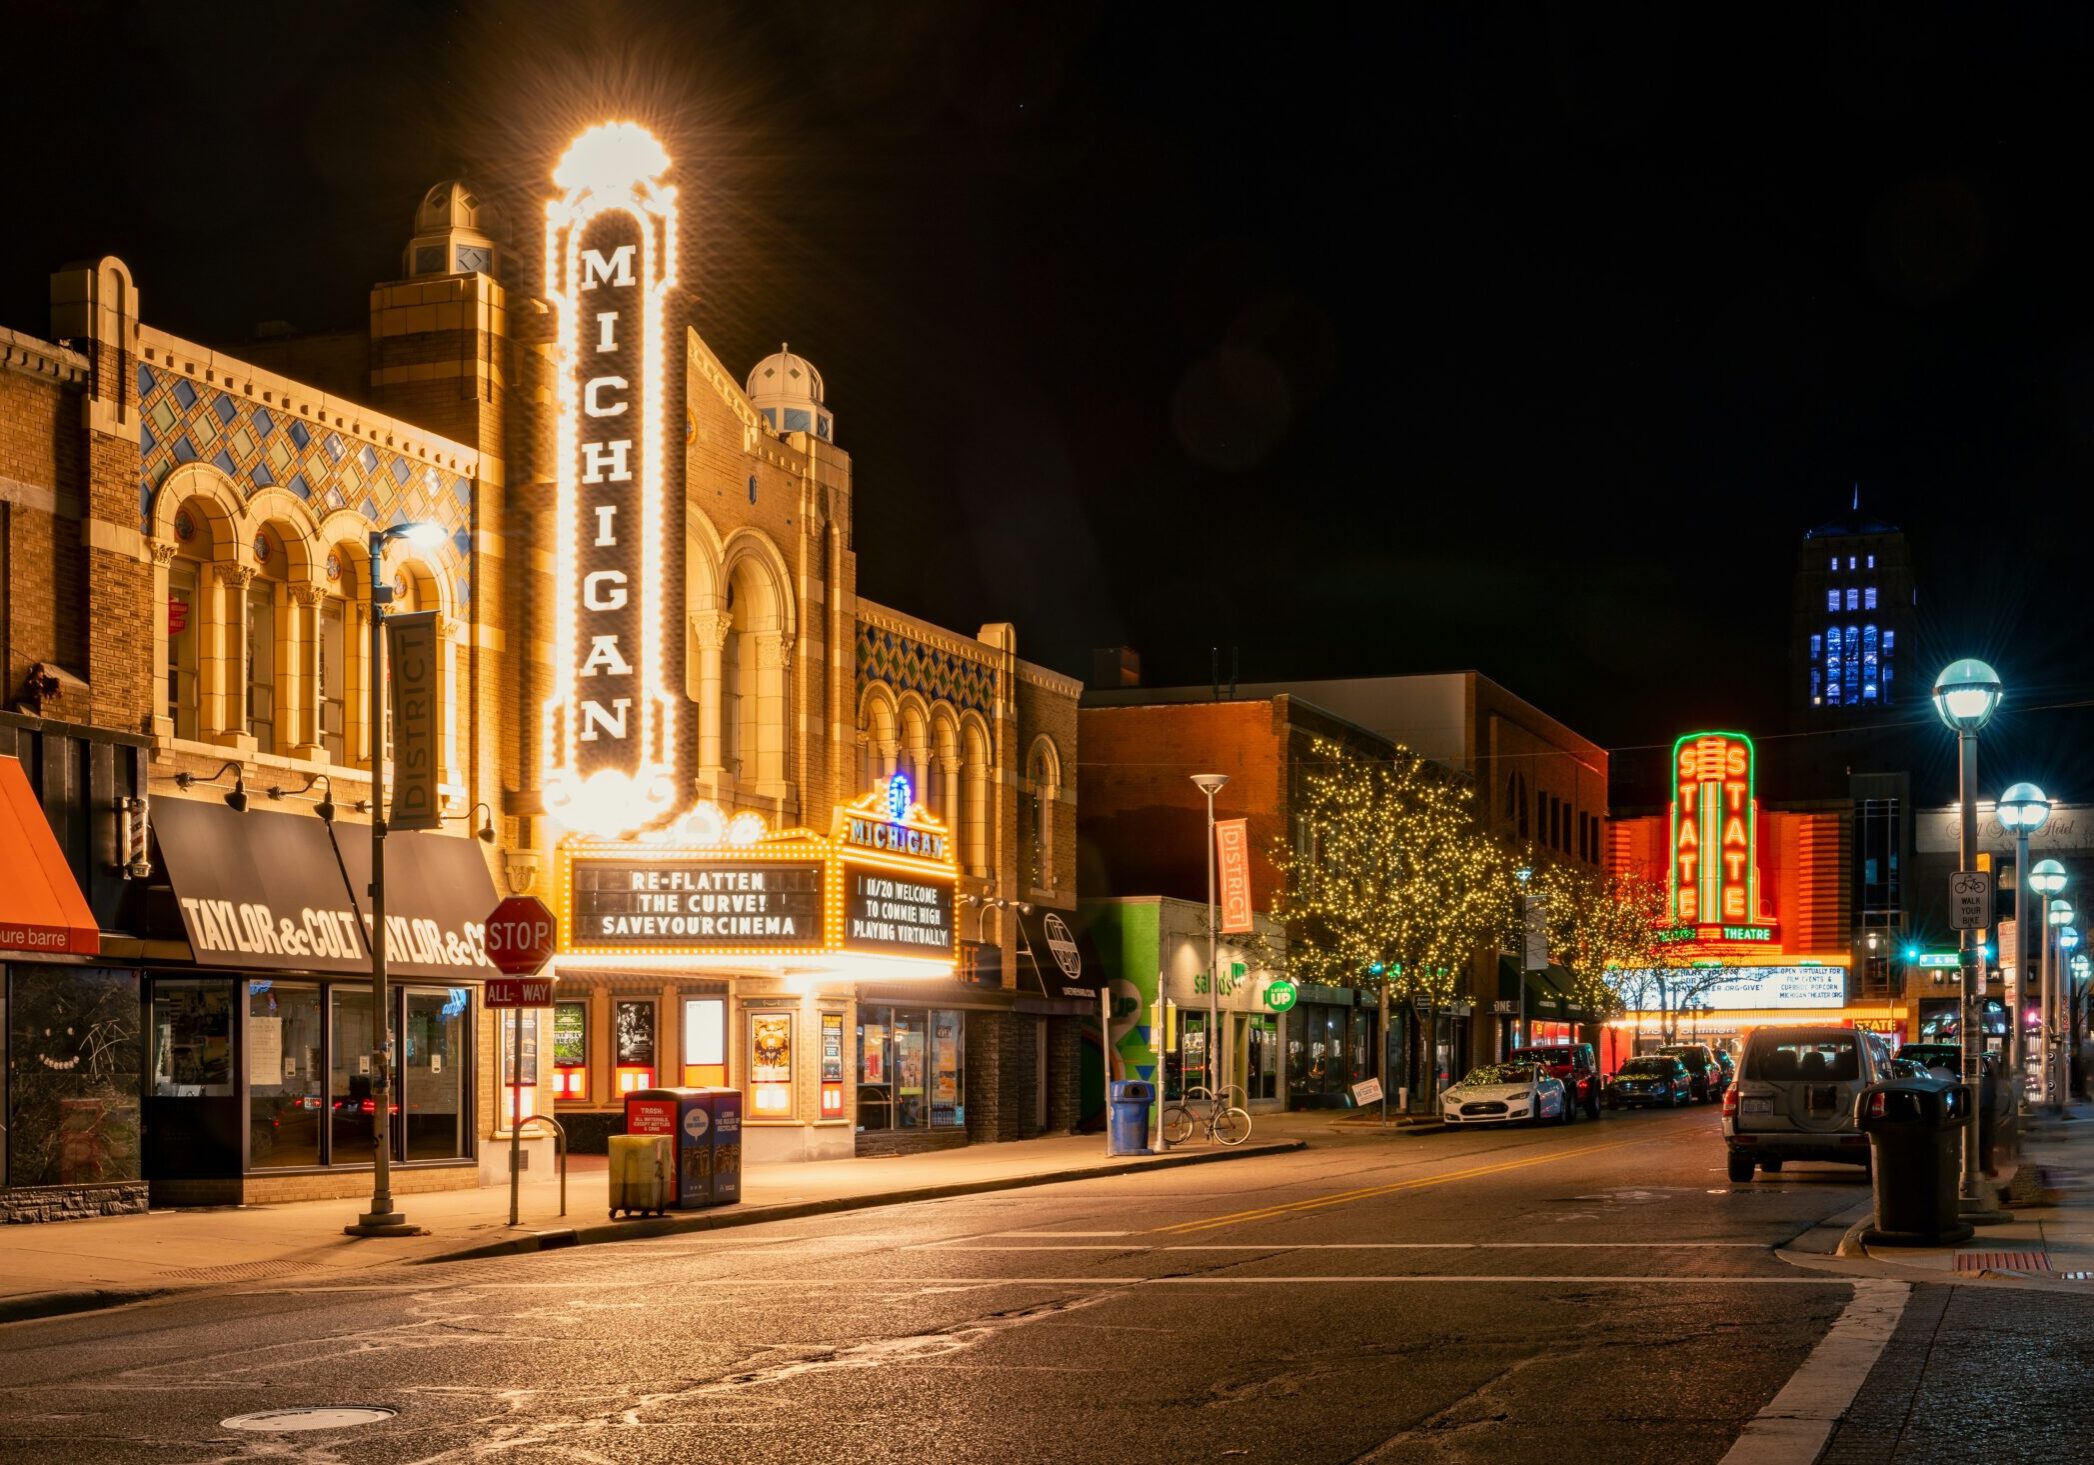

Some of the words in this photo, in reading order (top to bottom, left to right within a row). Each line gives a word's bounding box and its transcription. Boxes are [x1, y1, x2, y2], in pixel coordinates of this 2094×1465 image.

[580, 245, 636, 742] MICHIGAN
[402, 634, 426, 810] DISTRICT
[1679, 748, 1697, 917] STATE
[1724, 747, 1746, 916] STATE
[2034, 817, 2075, 838] Hotel
[850, 818, 944, 860] MICHIGAN
[632, 872, 764, 891] RE-FLATTEN
[1224, 831, 1245, 923] DISTRICT
[895, 882, 937, 905] WELCOME
[1961, 897, 1980, 905] WALK
[641, 894, 677, 913] THE
[688, 894, 767, 912] CURVE!
[866, 899, 879, 918] TO
[881, 902, 917, 923] COMMIE
[918, 906, 941, 925] HIGH
[1961, 907, 1981, 915] YOUR
[602, 916, 795, 935] SAVEYOURCINEMA
[1962, 916, 1980, 924] BIKE
[0, 930, 25, 944] ure
[28, 928, 66, 947] barre
[489, 921, 549, 950] STOP
[853, 919, 895, 940] PLAYING
[897, 925, 947, 947] VIRTUALLY
[1724, 928, 1771, 941] THEATRE
[1829, 967, 1841, 975] FOR
[1194, 969, 1232, 996] salds
[487, 985, 512, 1002] ALL
[522, 984, 548, 1002] WAY
[1271, 992, 1291, 1005] UP
[1494, 1001, 1511, 1012] ONE
[1855, 1019, 1896, 1031] STATE
